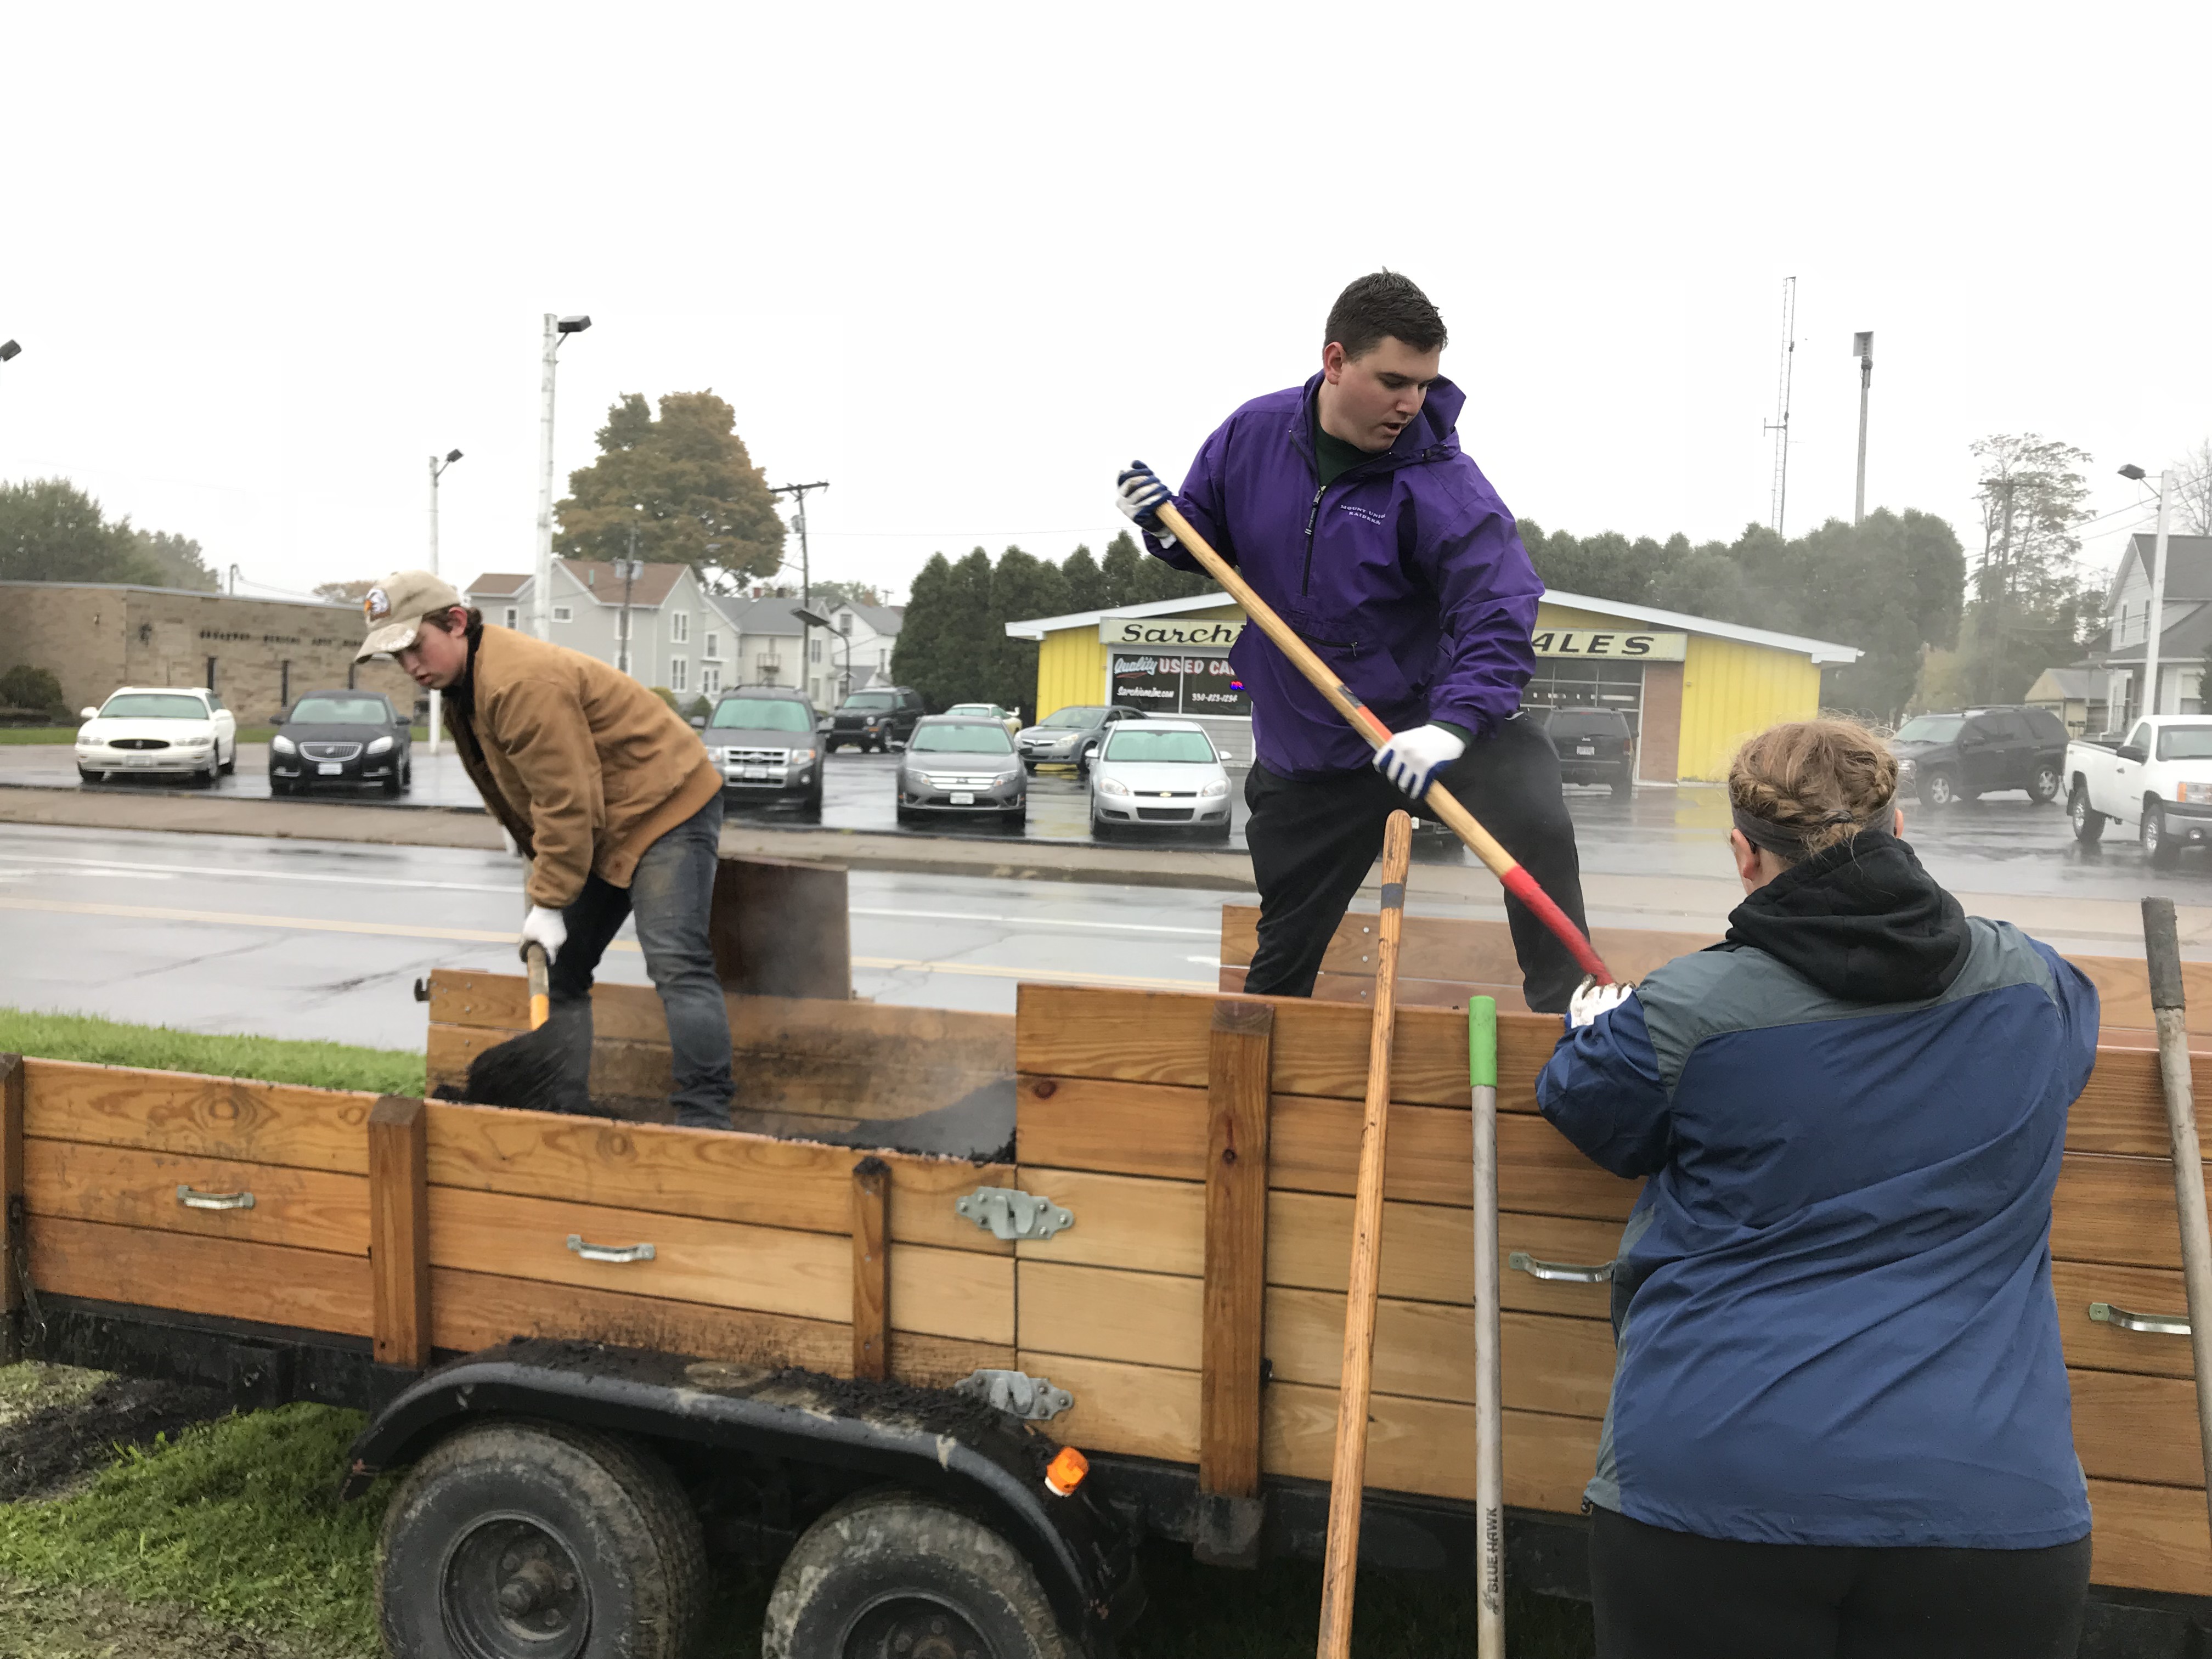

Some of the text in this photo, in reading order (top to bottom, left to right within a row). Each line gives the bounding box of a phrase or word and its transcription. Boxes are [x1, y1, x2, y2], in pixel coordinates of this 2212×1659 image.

[1340, 505, 1386, 519] MOUNT UNIO
[1114, 657, 1158, 675] Quality
[1159, 658, 1205, 675] USED
[1486, 1507, 1499, 1593] BLUE HAWK
